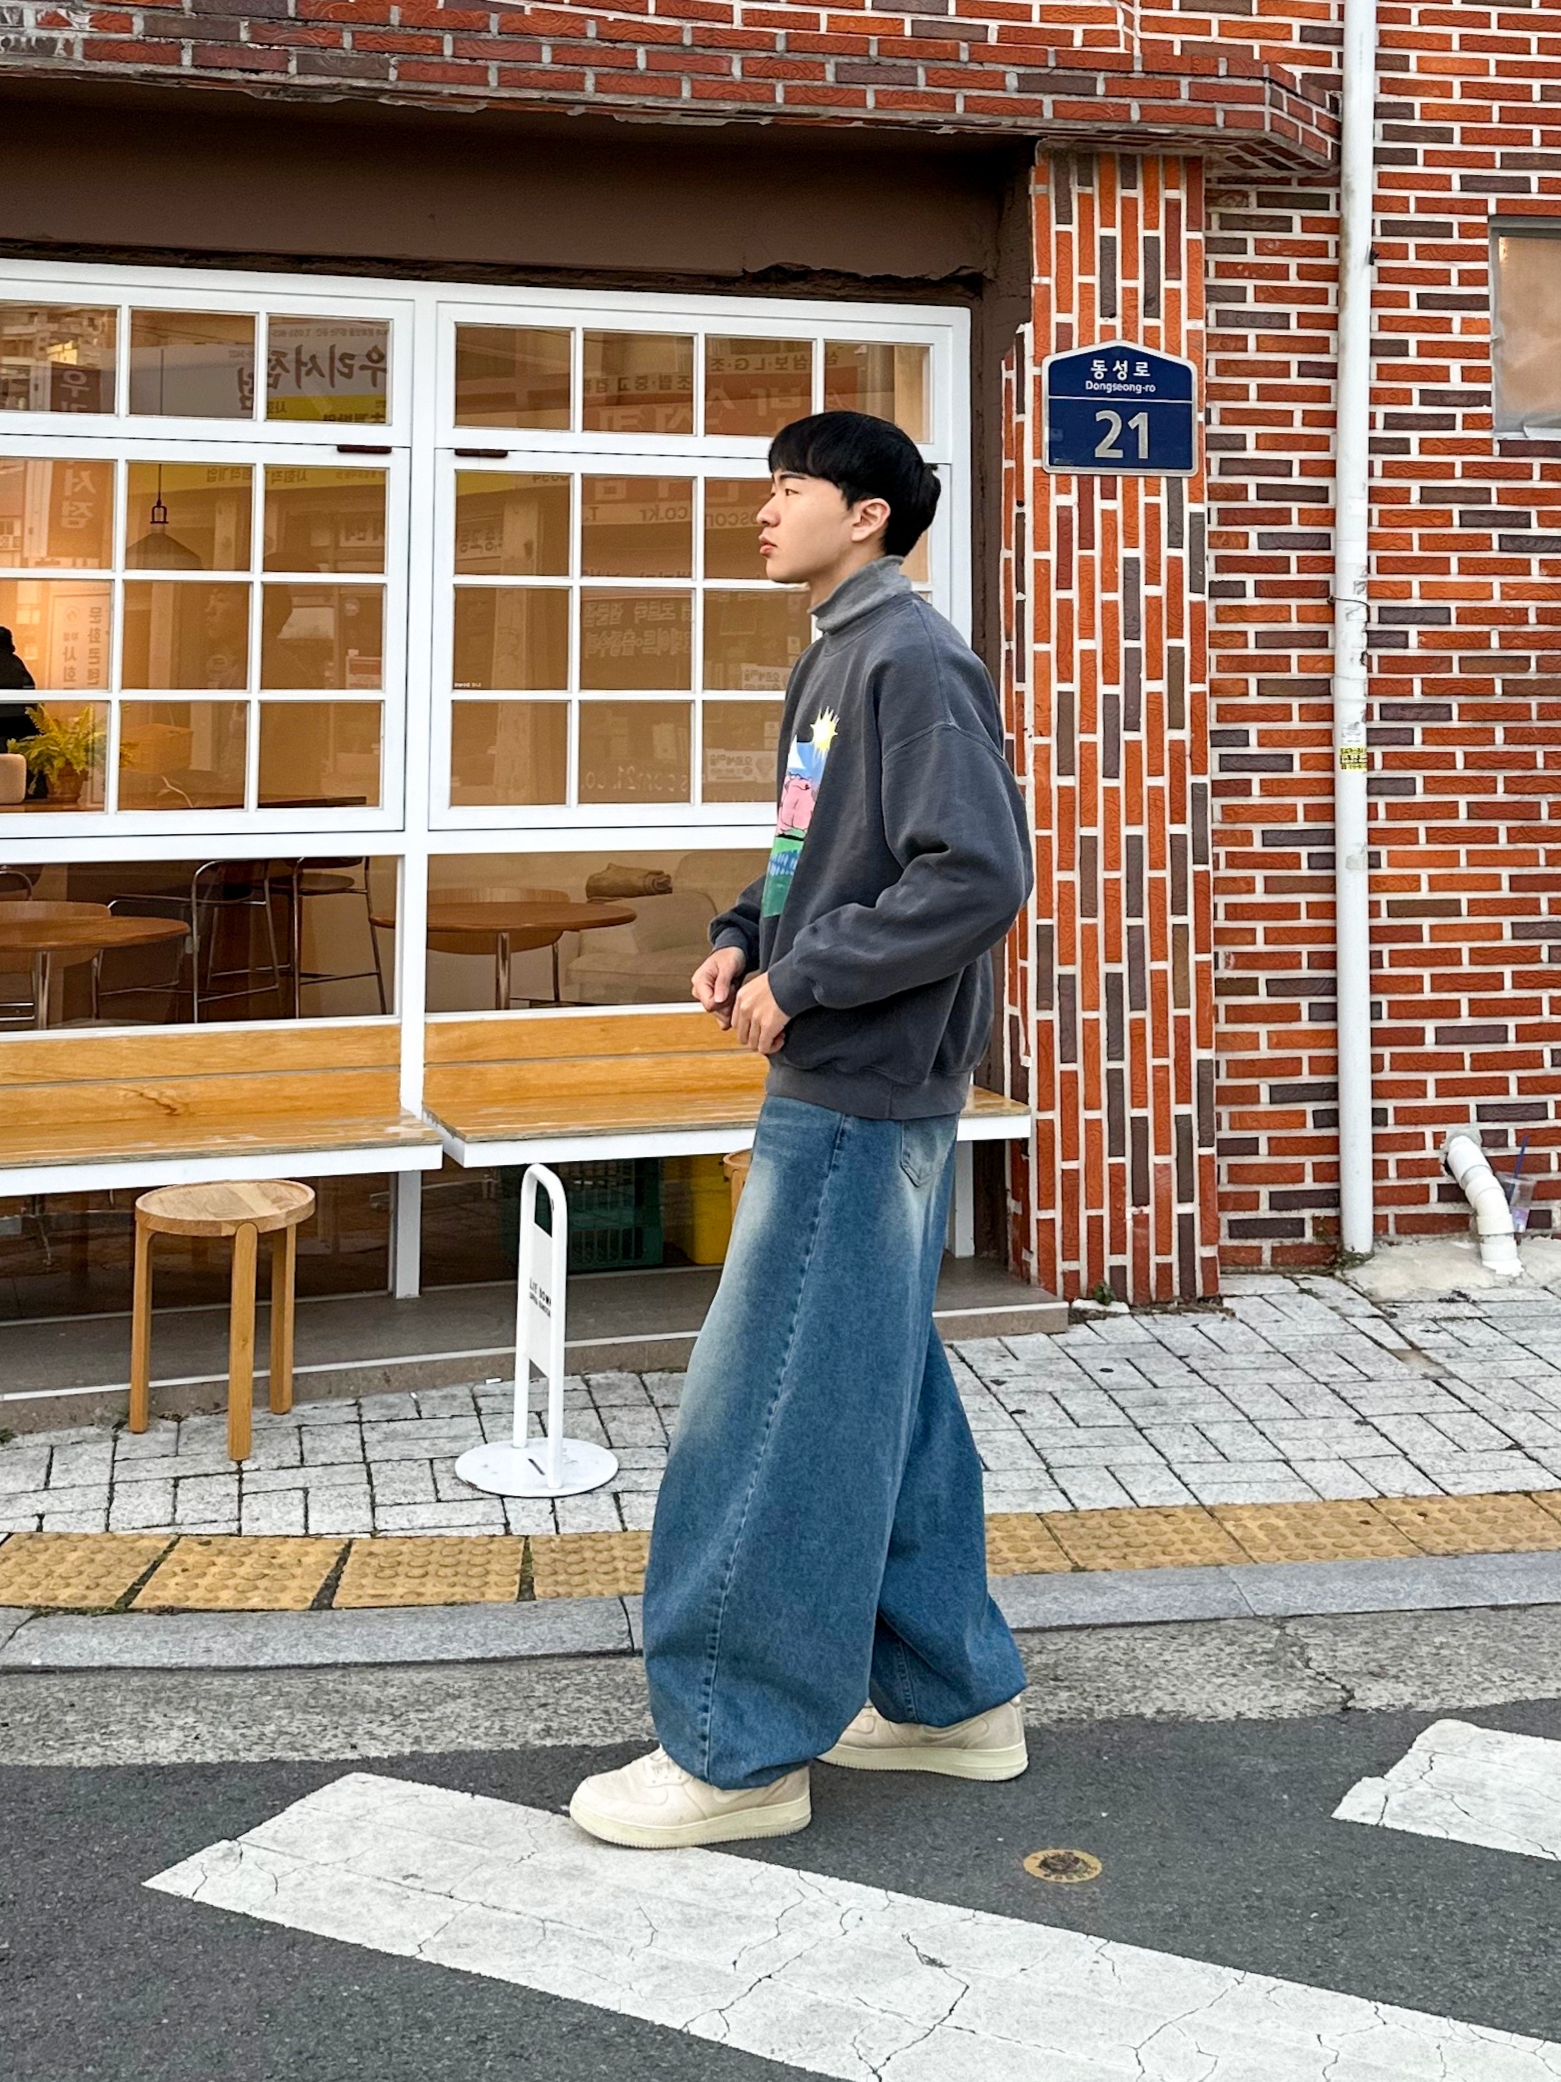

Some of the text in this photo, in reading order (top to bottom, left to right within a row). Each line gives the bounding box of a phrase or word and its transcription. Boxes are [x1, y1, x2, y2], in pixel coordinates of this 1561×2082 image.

[1090, 359, 1151, 381] 동성로
[1085, 380, 1156, 394] Dongseong-ro
[1094, 410, 1149, 459] 21
